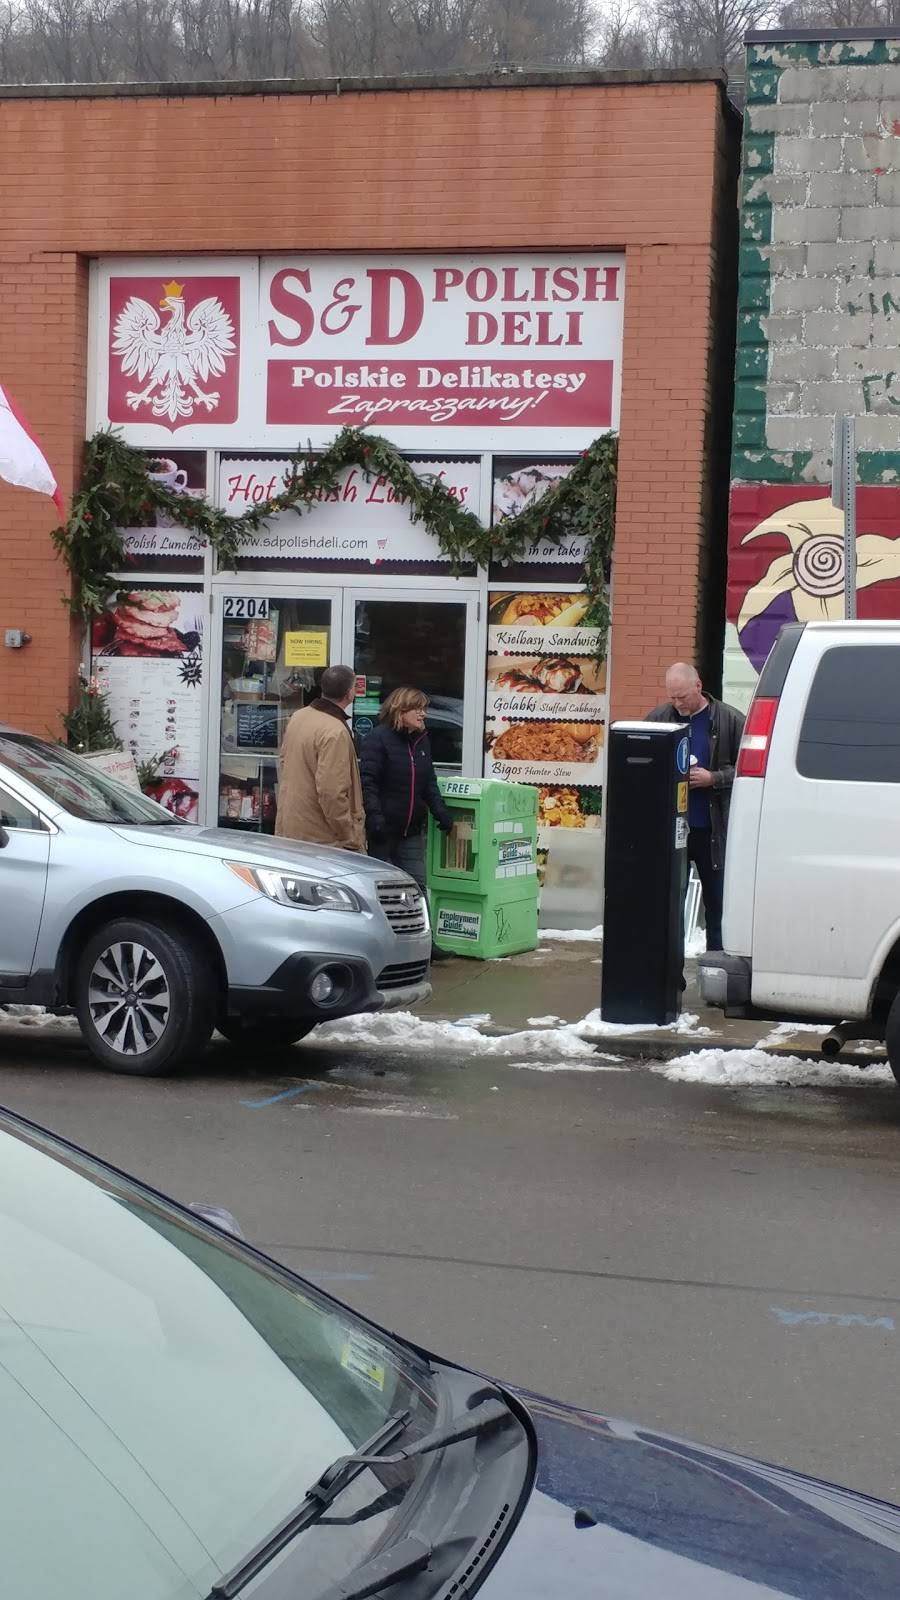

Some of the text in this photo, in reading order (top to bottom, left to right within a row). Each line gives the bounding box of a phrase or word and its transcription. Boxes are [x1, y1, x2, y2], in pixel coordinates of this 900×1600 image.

[268, 267, 620, 347] S&D POLISH
[465, 311, 583, 346] DELI
[291, 366, 587, 393] Polskie Delikatesy
[328, 391, 549, 422] Zapraszamy!
[227, 474, 277, 504] Hot
[125, 534, 203, 552] Polish Lunches
[233, 535, 369, 551] www.sdpolishdeli.com
[543, 547, 555, 557] or
[557, 542, 582, 557] take
[225, 599, 268, 618] 2204
[496, 630, 602, 651] Kielbasy Sandwich
[493, 696, 601, 717] Golabki Stuffed Cabbage
[491, 761, 572, 780] Bigos Hunter Stew
[446, 782, 470, 794] FREE
[439, 910, 479, 925] Employment
